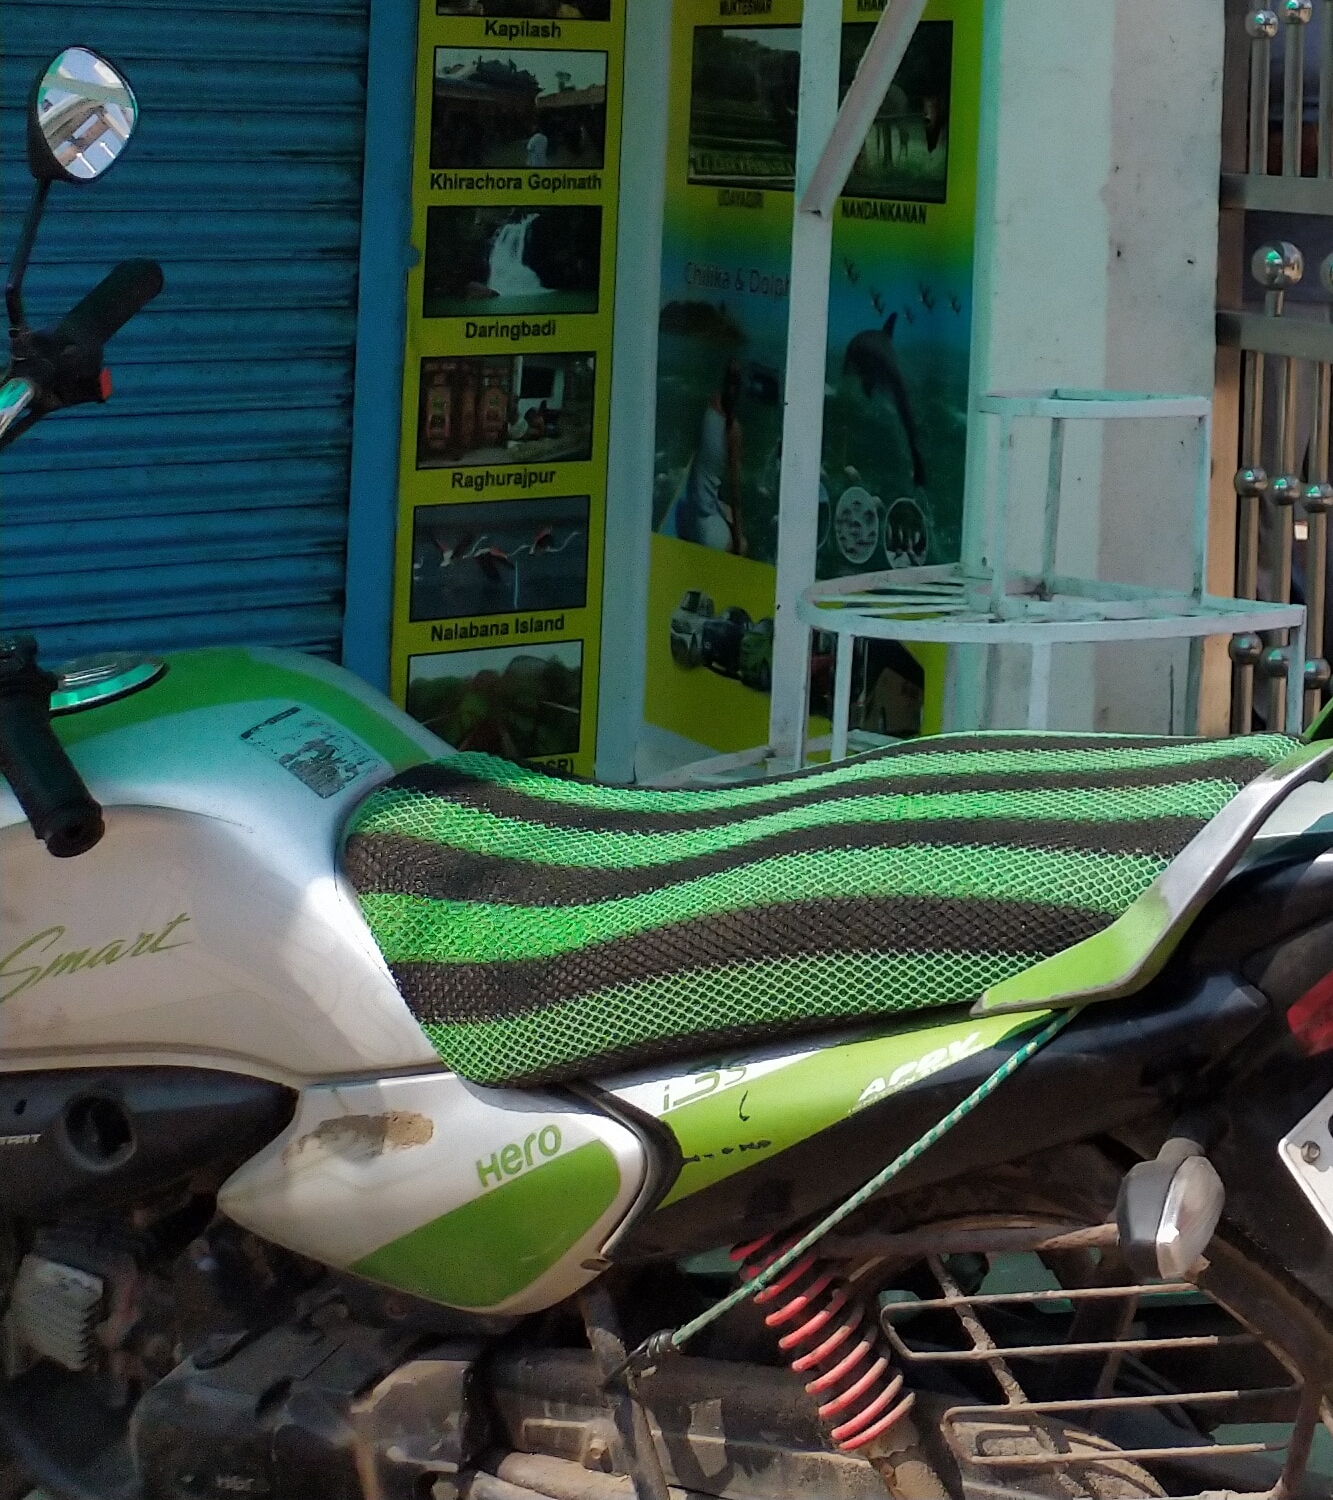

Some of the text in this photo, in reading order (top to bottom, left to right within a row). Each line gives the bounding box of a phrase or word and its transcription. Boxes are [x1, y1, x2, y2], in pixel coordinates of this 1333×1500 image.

[484, 20, 562, 40] Kapilash
[430, 173, 602, 192] Khirachora Gopinath
[842, 200, 926, 224] NANDANKANAN
[464, 320, 556, 340] Daringbadi
[451, 470, 556, 492] Raghurajpur
[431, 614, 565, 642] Nalabana Island
[0, 912, 193, 1003] Smart
[476, 1123, 564, 1189] Hero
